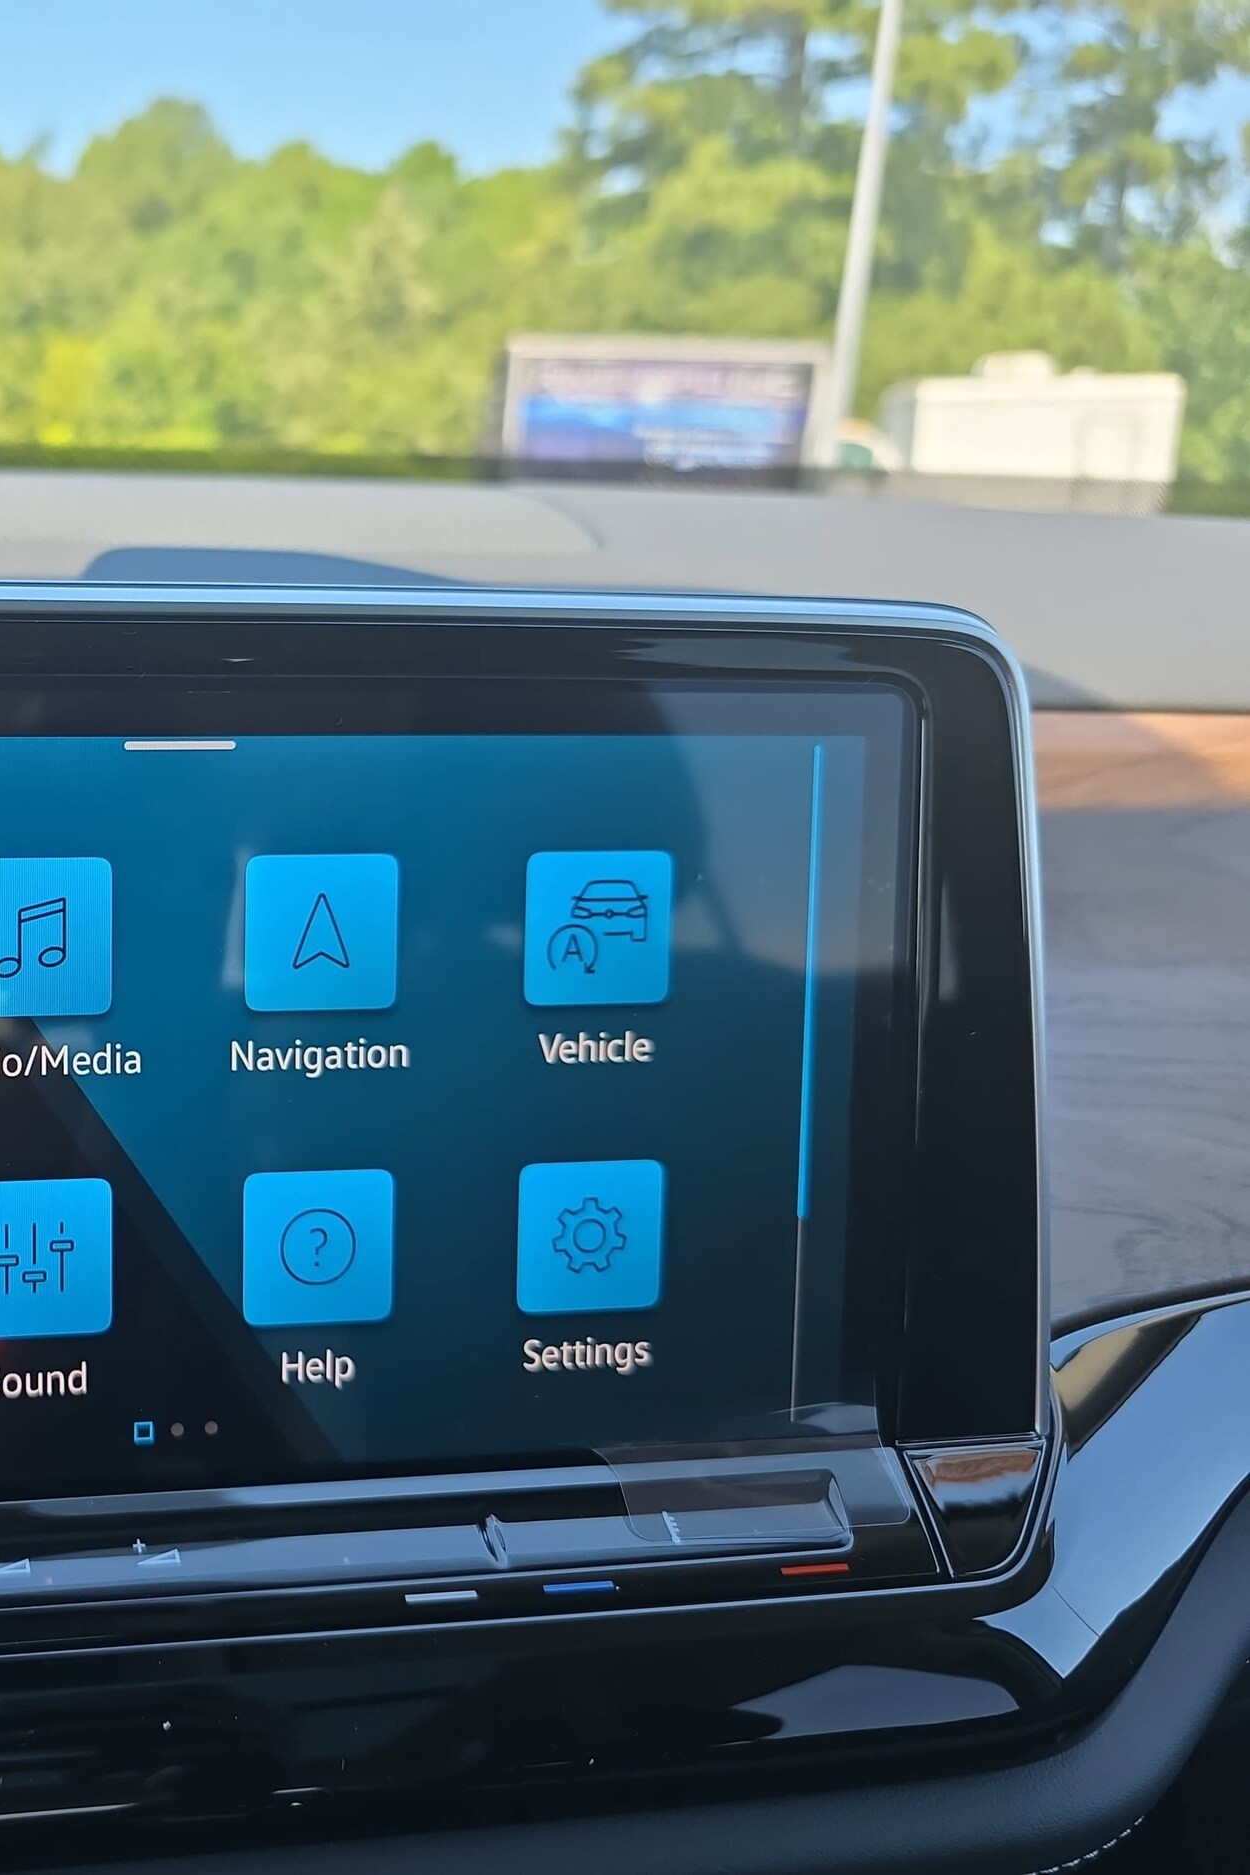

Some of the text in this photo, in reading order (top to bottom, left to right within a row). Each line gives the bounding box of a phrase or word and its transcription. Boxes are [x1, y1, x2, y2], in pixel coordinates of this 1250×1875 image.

[230, 1038, 411, 1079] Navigation
[538, 1030, 655, 1065] Vehicle
[280, 1349, 356, 1389] Help
[522, 1337, 654, 1376] Settings
